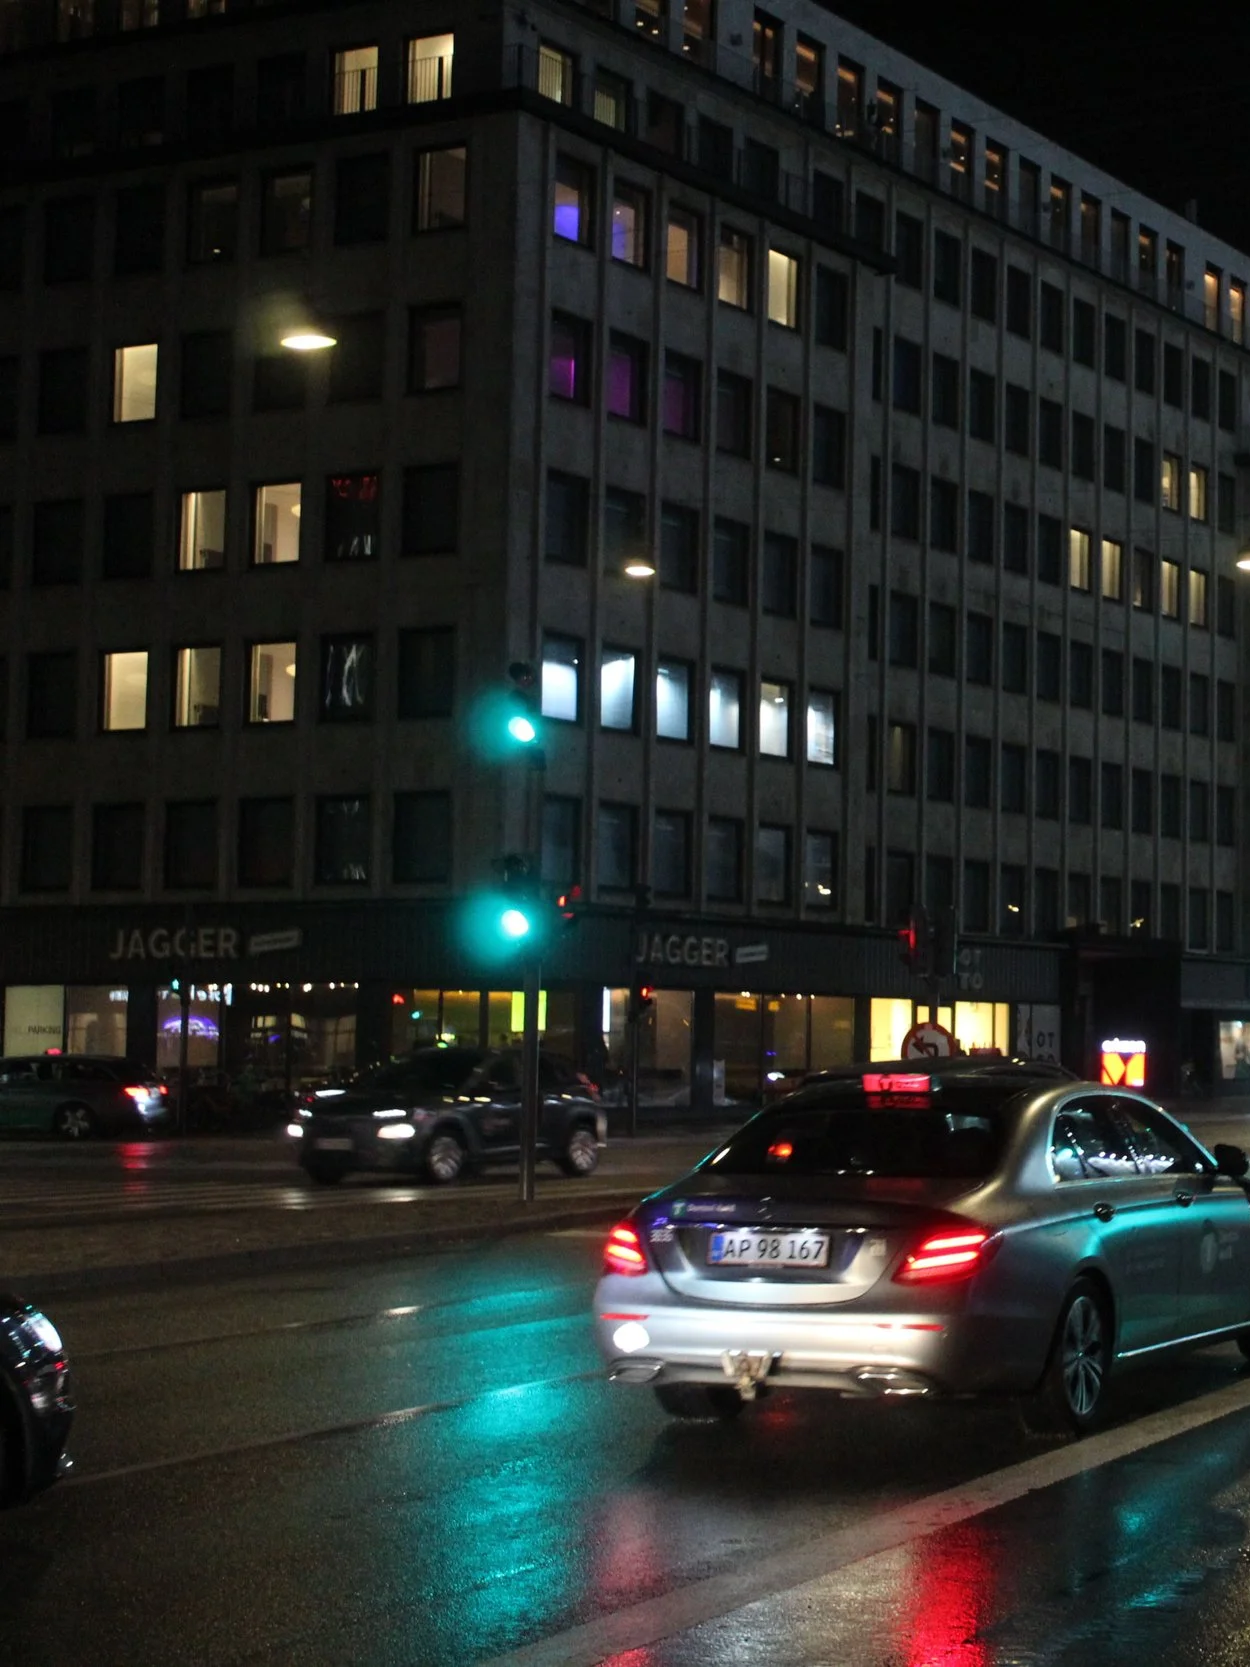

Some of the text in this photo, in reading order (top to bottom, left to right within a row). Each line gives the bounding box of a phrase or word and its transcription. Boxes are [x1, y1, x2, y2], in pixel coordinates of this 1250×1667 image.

[109, 927, 239, 960] JAGGER
[635, 933, 730, 967] JAGGER
[724, 1238, 825, 1260] AP 98 167
